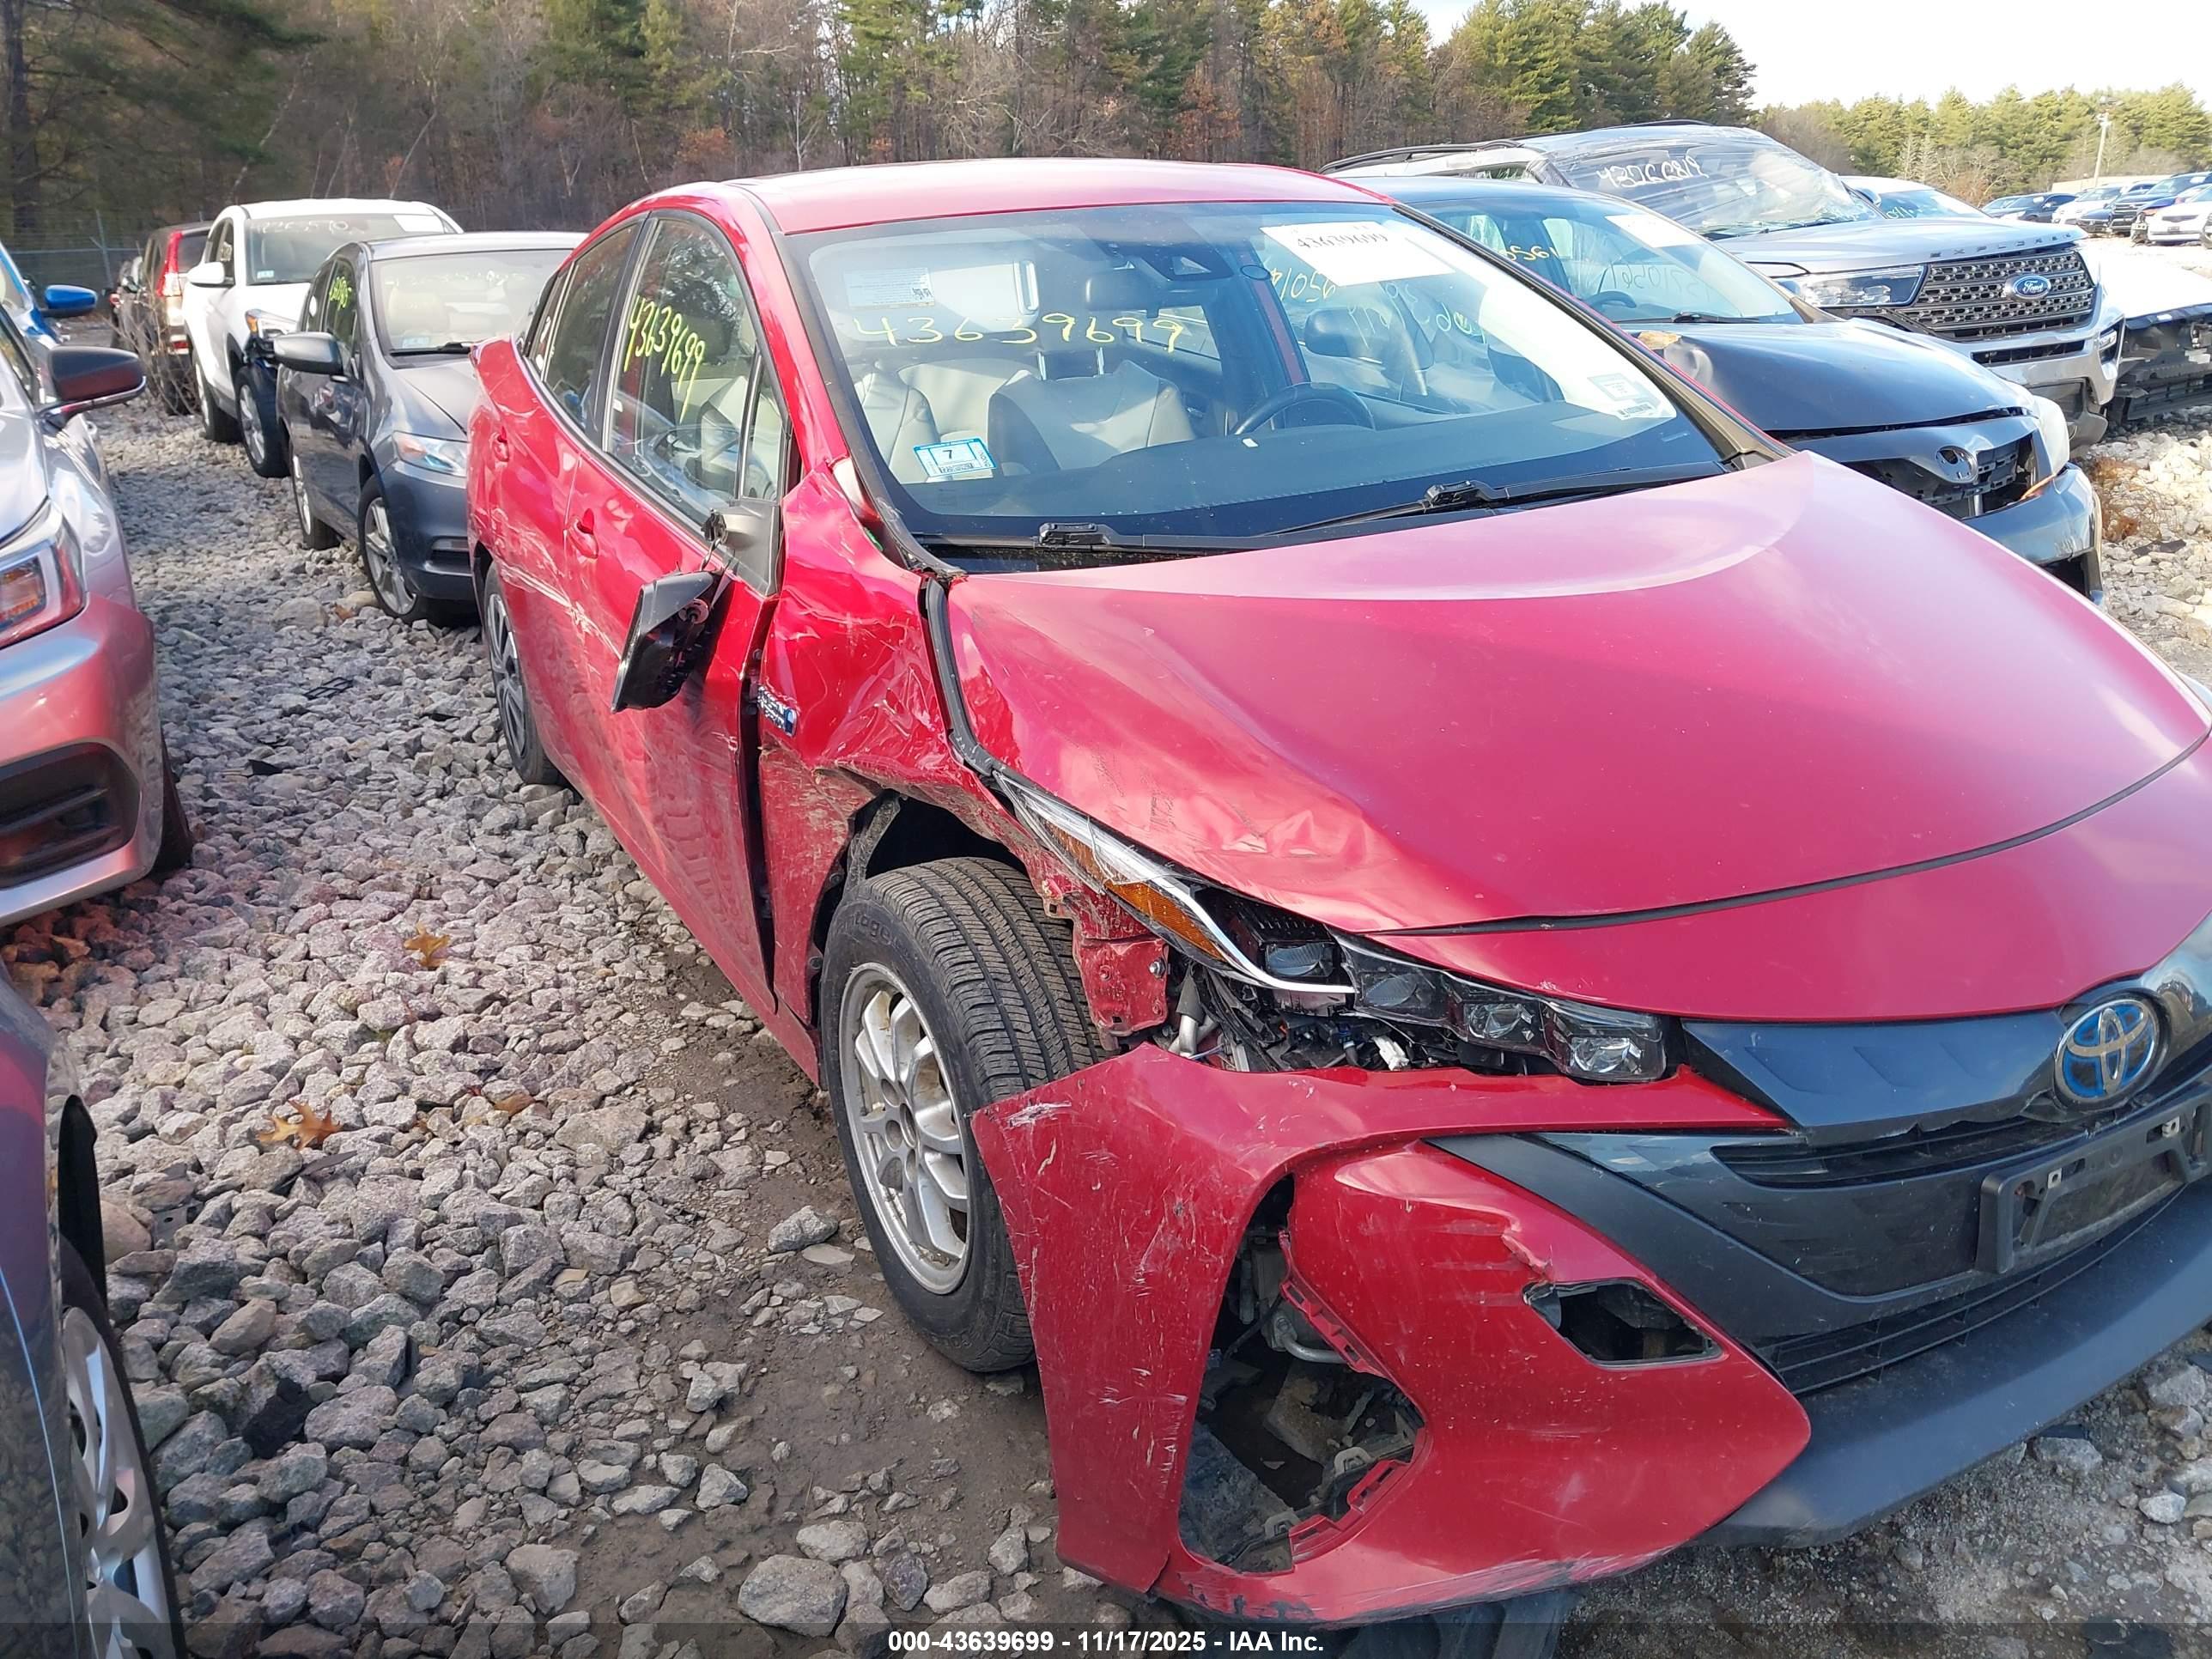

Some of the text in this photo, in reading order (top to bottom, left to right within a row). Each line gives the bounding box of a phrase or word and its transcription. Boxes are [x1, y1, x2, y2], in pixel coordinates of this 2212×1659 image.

[2021, 279, 2045, 294] Ford
[854, 313, 1183, 354] 43639699
[623, 295, 706, 424] 43639699
[942, 449, 953, 459] 7
